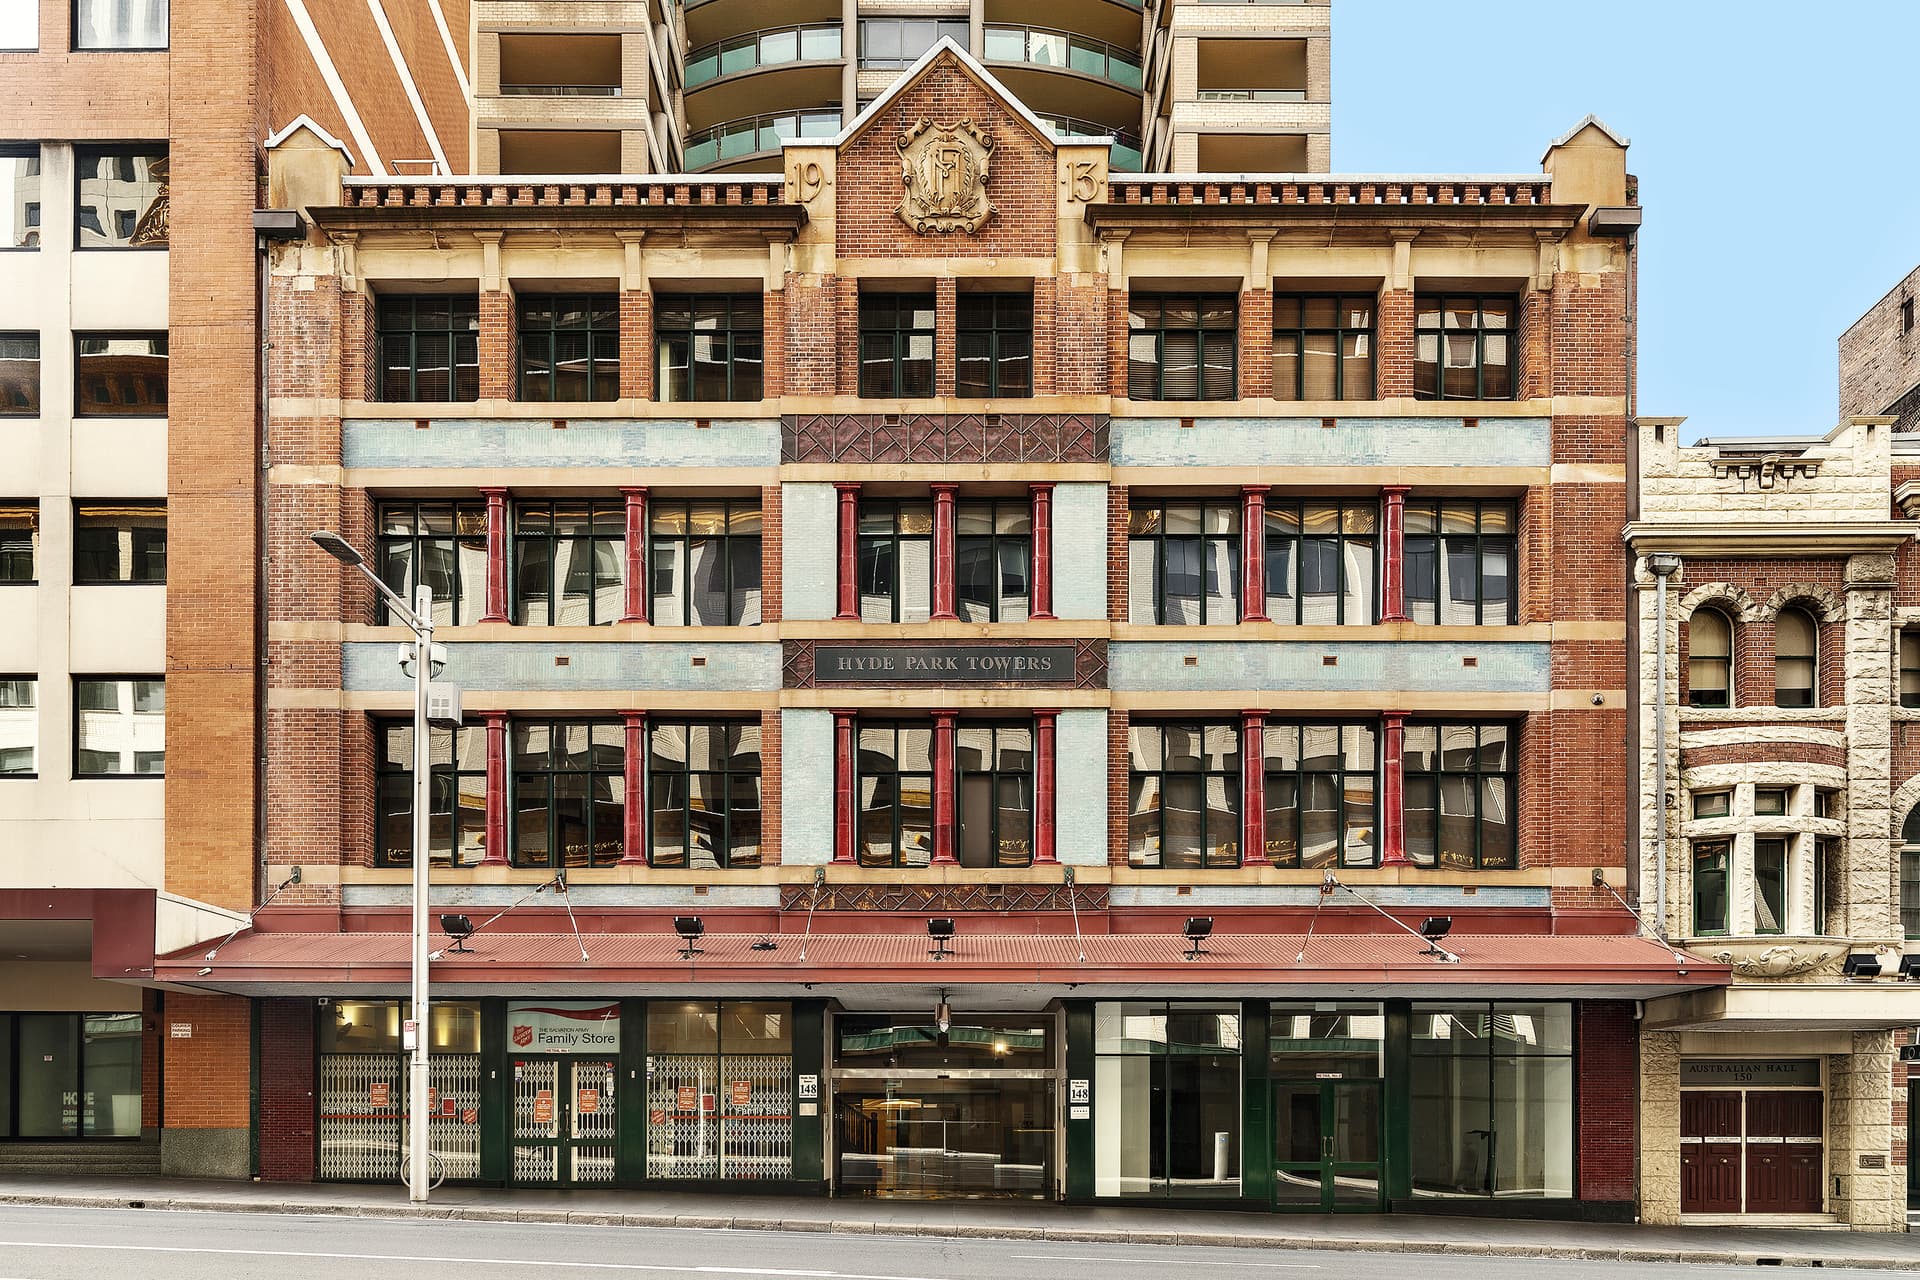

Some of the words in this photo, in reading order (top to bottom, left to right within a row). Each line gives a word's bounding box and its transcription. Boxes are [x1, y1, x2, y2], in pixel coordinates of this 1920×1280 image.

[793, 162, 824, 203] 19
[1066, 161, 1098, 202] 13
[837, 656, 895, 671] HYDE
[905, 656, 958, 671] PARK
[966, 656, 1052, 671] TOWERS
[538, 1032, 578, 1046] Family
[582, 1032, 615, 1044] Store
[1689, 1064, 1761, 1073] AUSTRALIAN
[1766, 1064, 1798, 1072] HALL
[1734, 1073, 1752, 1081] 150
[800, 1084, 817, 1094] 148
[1072, 1089, 1088, 1098] 148
[63, 1092, 95, 1105] HOE
